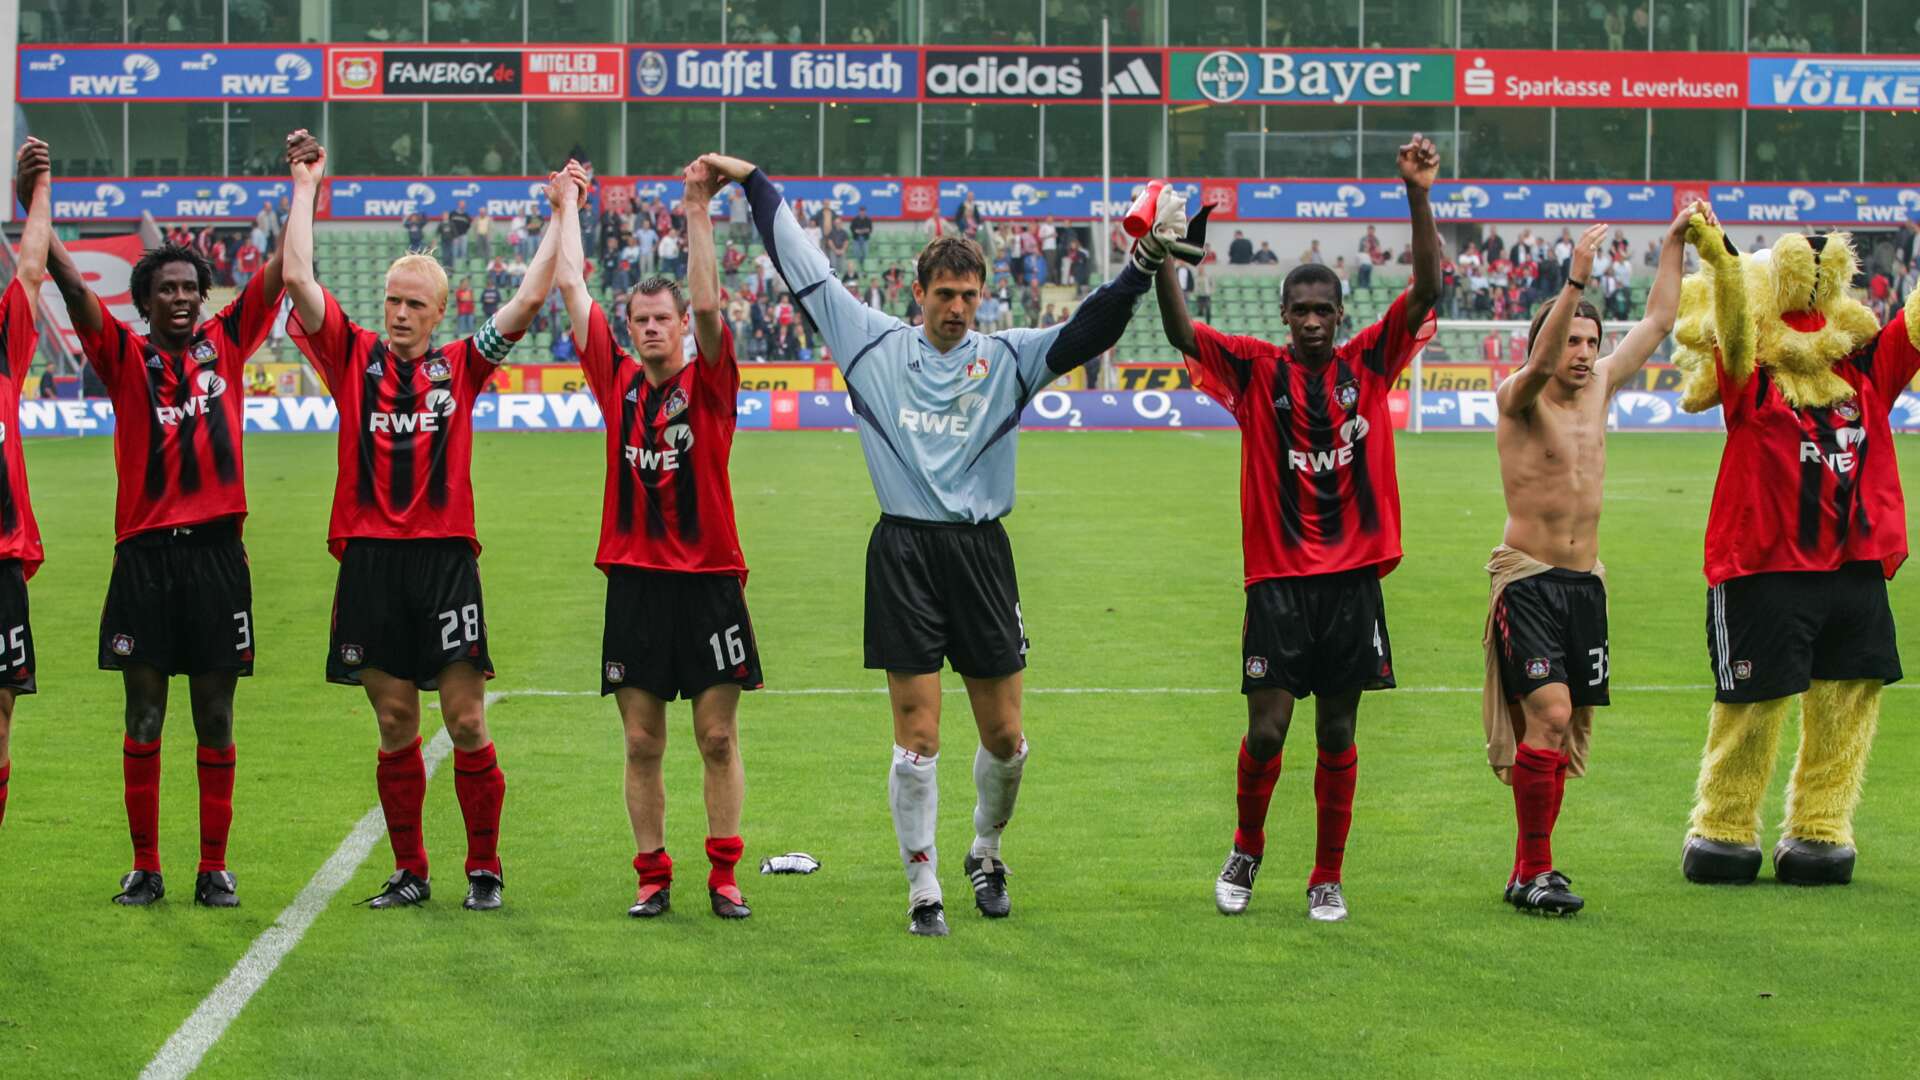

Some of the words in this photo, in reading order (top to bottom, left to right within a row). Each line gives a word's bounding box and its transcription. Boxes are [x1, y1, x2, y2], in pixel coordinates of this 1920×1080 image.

[529, 54, 596, 73] MITGLIED
[676, 50, 777, 96] Gaffel
[790, 51, 902, 93] Kölsch
[70, 75, 138, 95] RWE
[221, 75, 289, 94] RWE
[548, 74, 614, 93] WERDEN!
[926, 57, 1083, 95] adidas
[1258, 53, 1421, 103] Bayer
[1505, 77, 1611, 99] Sparkasse
[1621, 78, 1739, 98] Leverkusen
[55, 202, 107, 217] RWE
[177, 200, 230, 216] RWE
[364, 200, 418, 216] RWE
[1296, 202, 1348, 217] RWE
[1544, 203, 1595, 218] RWE
[1748, 204, 1799, 220] RWE
[1857, 205, 1908, 221] RWE
[156, 394, 210, 426] RWE
[244, 397, 338, 430] RW
[369, 412, 439, 432] RWE
[497, 394, 602, 428] RW
[898, 407, 969, 437] RWE
[625, 445, 680, 471] RWE
[1288, 442, 1354, 472] RWE
[233, 611, 250, 650] 3
[438, 603, 479, 650] 28
[1373, 619, 1383, 656] 4
[709, 623, 746, 671] 16
